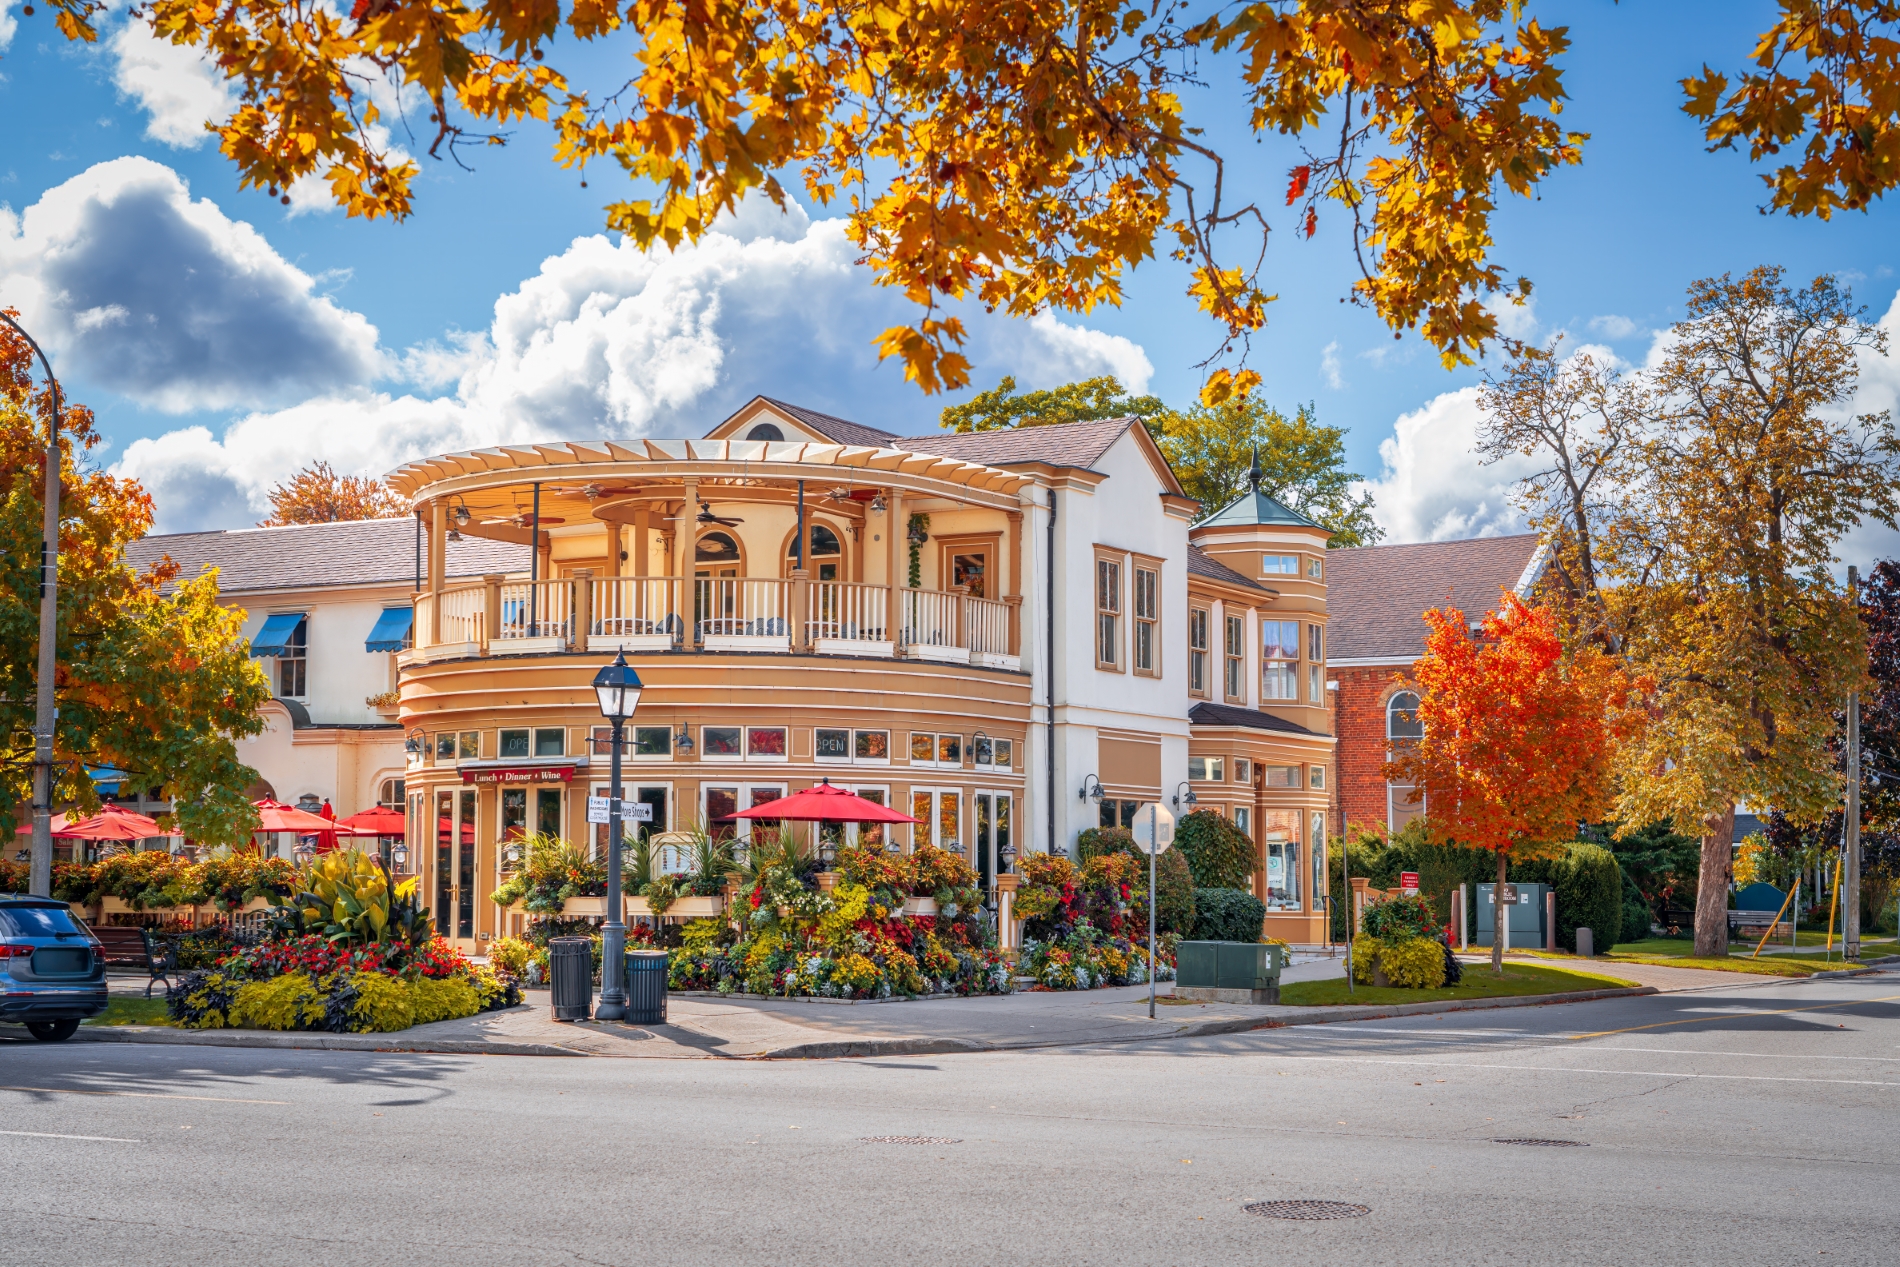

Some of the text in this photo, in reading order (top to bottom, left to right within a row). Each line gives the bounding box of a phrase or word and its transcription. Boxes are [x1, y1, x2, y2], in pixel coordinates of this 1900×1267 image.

[509, 737, 529, 750] OPE
[816, 738, 844, 751] OPEN
[474, 771, 561, 782] Lunch Dinner Wine
[620, 805, 645, 818] More Shops
[58, 837, 73, 845] Sale
